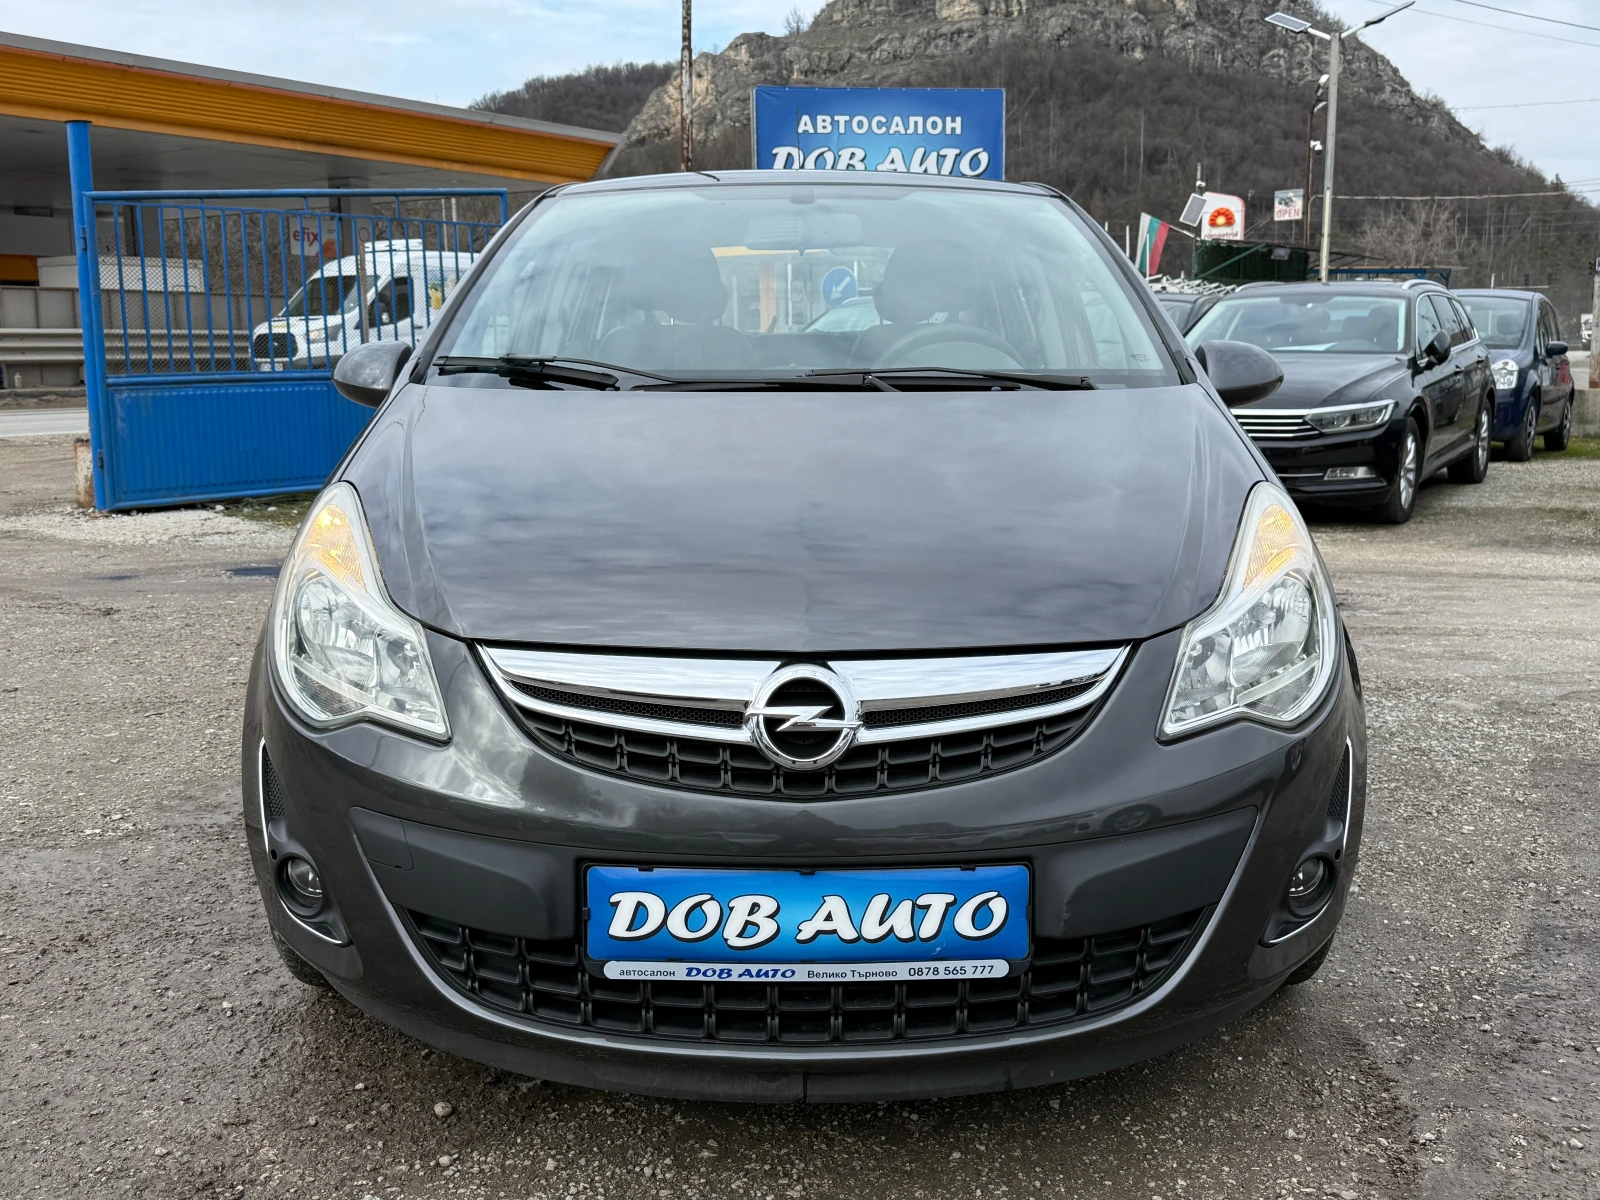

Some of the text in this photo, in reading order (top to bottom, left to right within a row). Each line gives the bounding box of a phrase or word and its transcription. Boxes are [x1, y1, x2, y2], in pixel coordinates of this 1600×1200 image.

[797, 114, 963, 135] АВТОСАЛОН
[771, 146, 990, 177] DOB AUTO
[1276, 208, 1300, 218] OPEN
[608, 890, 1010, 950] DOB AUTO
[619, 965, 995, 980] автосалон DOB AUTO Велико Търново 0878 565 777
